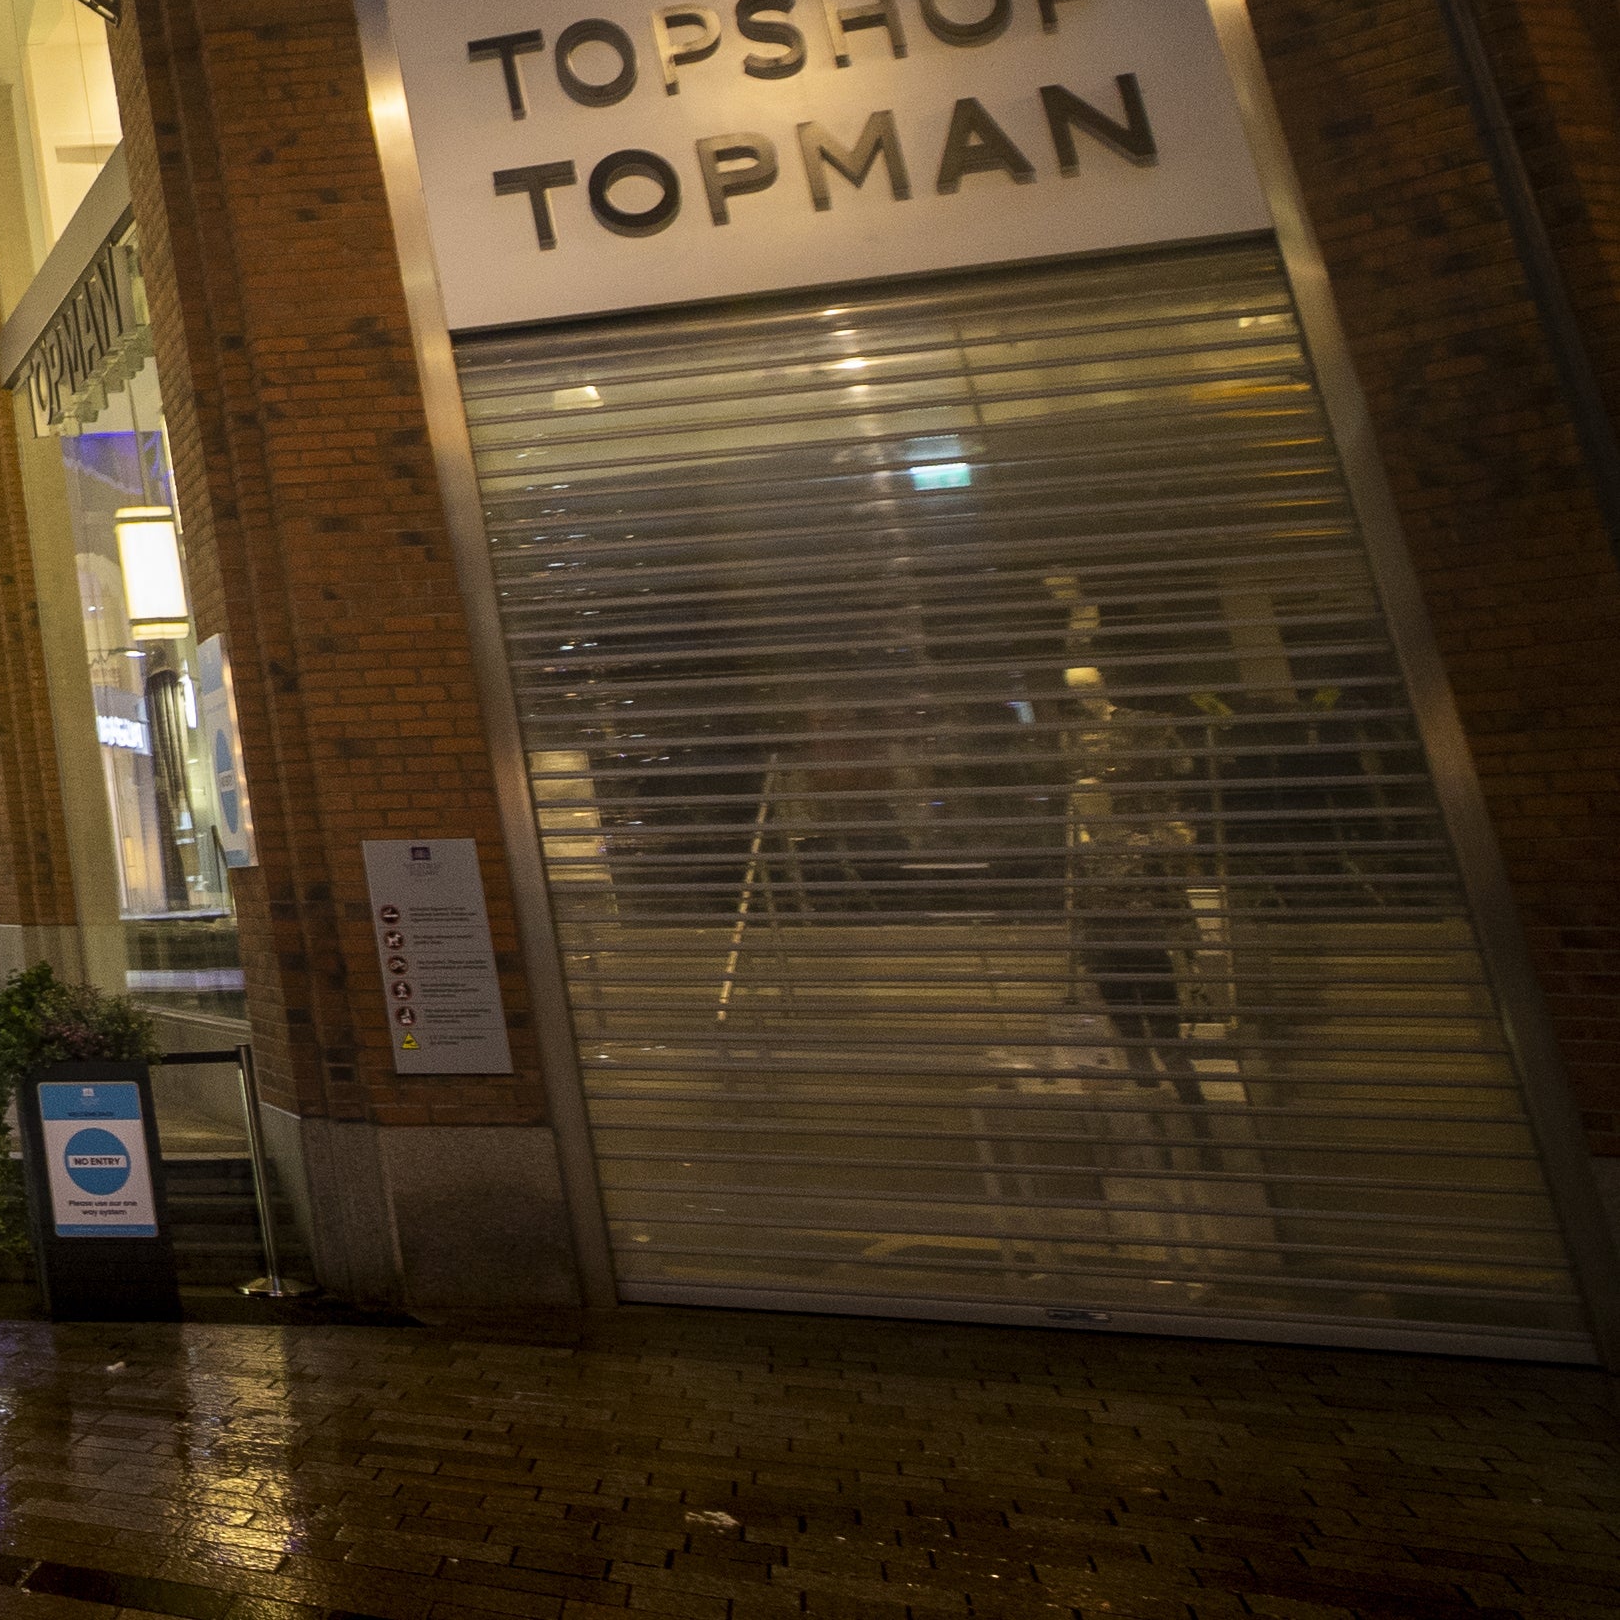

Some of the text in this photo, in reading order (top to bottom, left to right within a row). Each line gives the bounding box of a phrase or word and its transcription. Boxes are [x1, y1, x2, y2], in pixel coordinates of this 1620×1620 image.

[492, 72, 1159, 251] TOPMAN
[18, 246, 132, 439] TOPMAN
[74, 1157, 121, 1166] NO ENTRY
[68, 1199, 93, 1207] Please
[123, 1200, 138, 1208] one
[82, 1208, 127, 1217] way system
